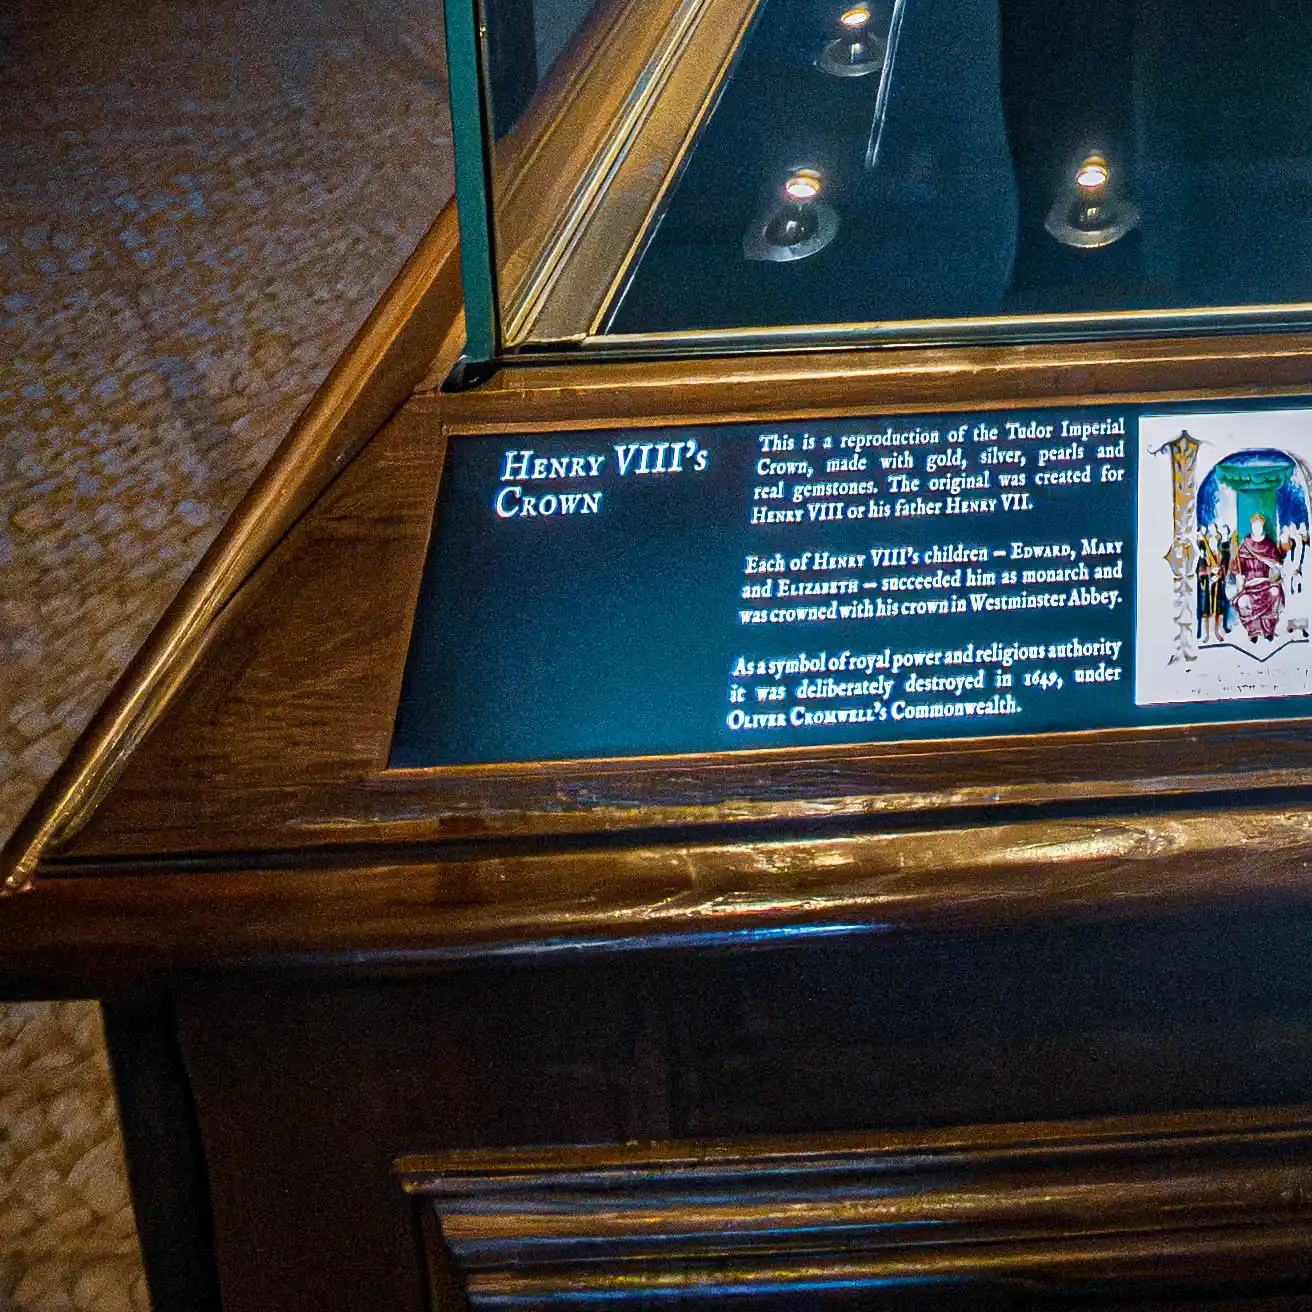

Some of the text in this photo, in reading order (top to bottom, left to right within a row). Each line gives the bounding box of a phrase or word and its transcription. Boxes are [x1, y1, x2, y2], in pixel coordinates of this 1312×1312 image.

[759, 417, 1125, 453] This is a reproduction of the Tudor Imperial
[501, 450, 604, 482] HENRY
[757, 440, 1125, 479] Crown, made with gold, silver, pearls and
[496, 486, 602, 518] CROWN
[753, 464, 1125, 503] real gemstones. The original was created for
[750, 493, 1033, 525] HENRY VIII or his father HENRY VII.
[744, 553, 785, 575] Each
[789, 552, 812, 571] of
[812, 552, 866, 570] HENRY
[924, 544, 988, 565] children
[1010, 542, 1076, 561] EDWARD,
[1081, 538, 1123, 556] MARY
[741, 579, 773, 599] and
[777, 578, 859, 598] ELIZABETH
[881, 569, 961, 591] succeeded
[965, 568, 996, 587] him
[1001, 570, 1017, 584] as
[1022, 562, 1089, 585] monarch
[1094, 560, 1123, 579] and
[740, 586, 1123, 625] was crowned with his crown in Westminster Abbey.
[732, 638, 1123, 680] As a symbol of royal power and religious authority
[729, 662, 1122, 703] it was deliberately destroyed in 1649, under
[726, 709, 787, 730] OLIVER
[891, 694, 1022, 721] Commonwealth.
